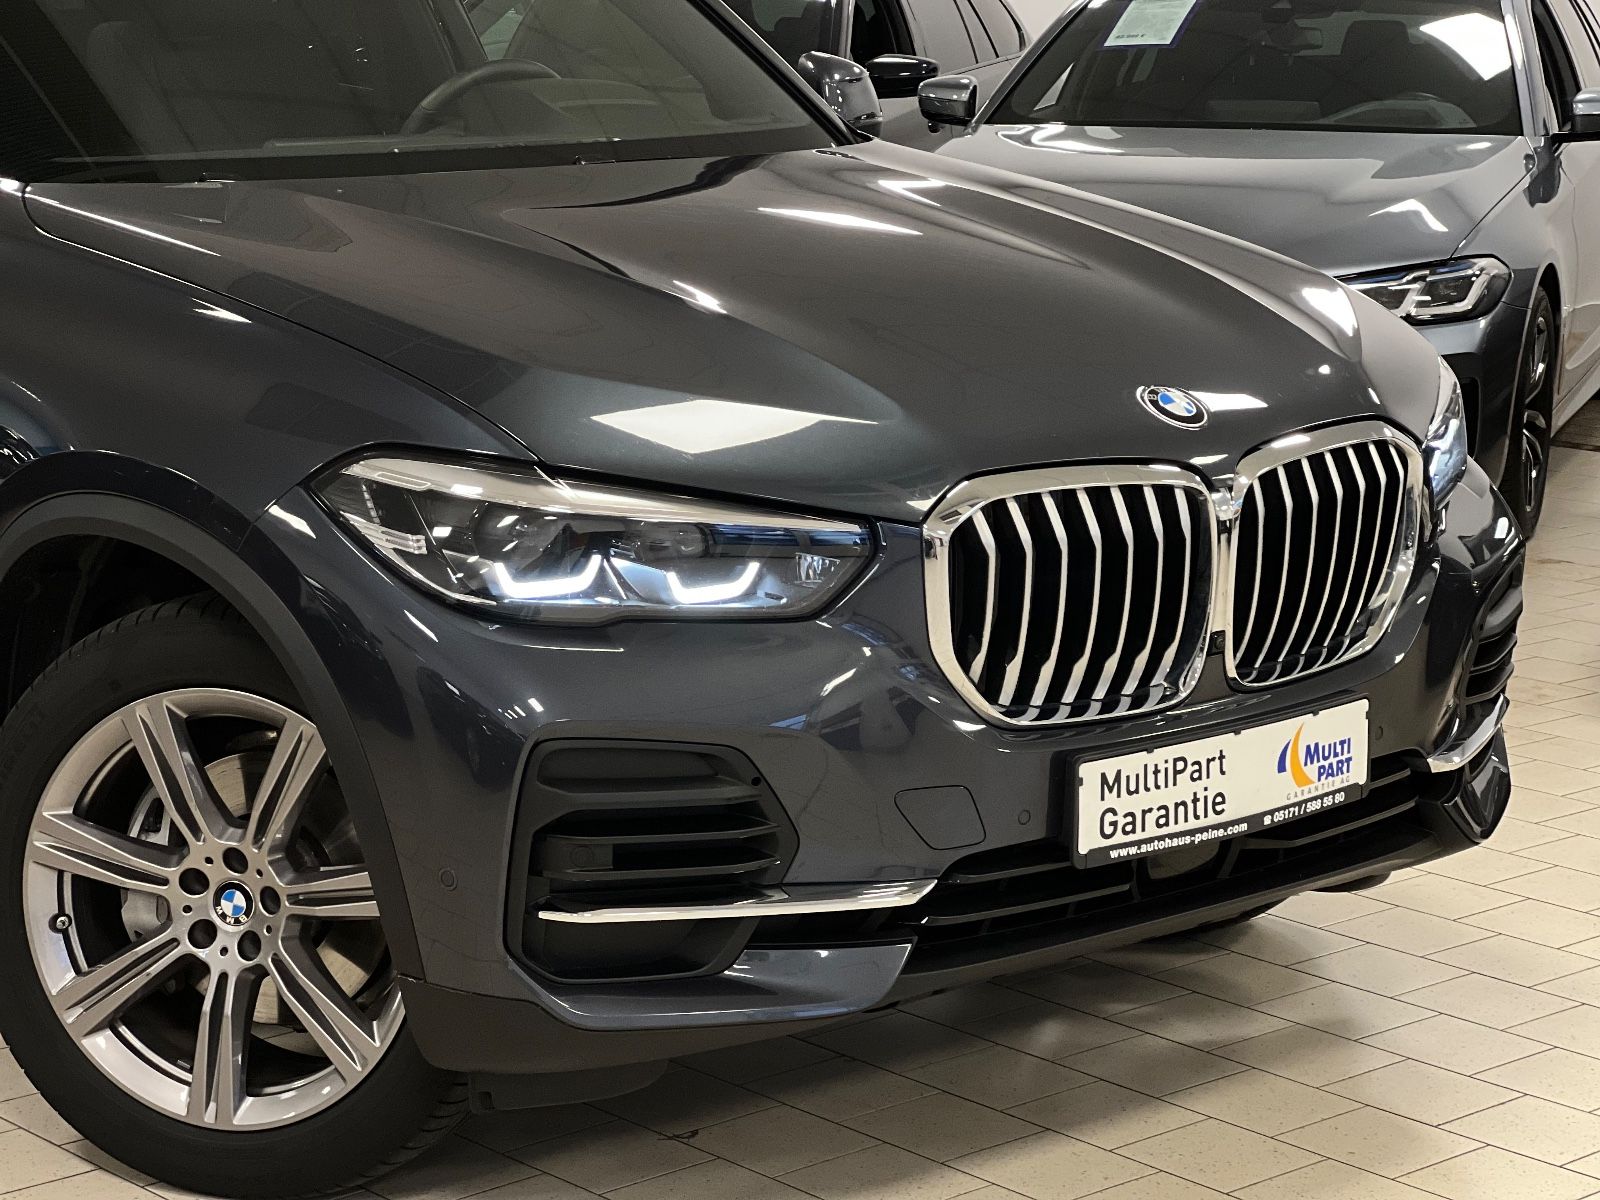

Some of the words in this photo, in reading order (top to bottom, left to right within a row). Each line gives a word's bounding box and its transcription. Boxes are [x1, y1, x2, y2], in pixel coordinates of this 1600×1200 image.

[1100, 749, 1226, 801] MultiPart
[1317, 756, 1352, 782] PART
[1286, 782, 1336, 801] GARANTIE
[1340, 775, 1350, 784] AG
[1099, 786, 1226, 840] Garantie
[1273, 805, 1299, 823] 05171
[1109, 821, 1248, 859] www.autohaus-peine.com
